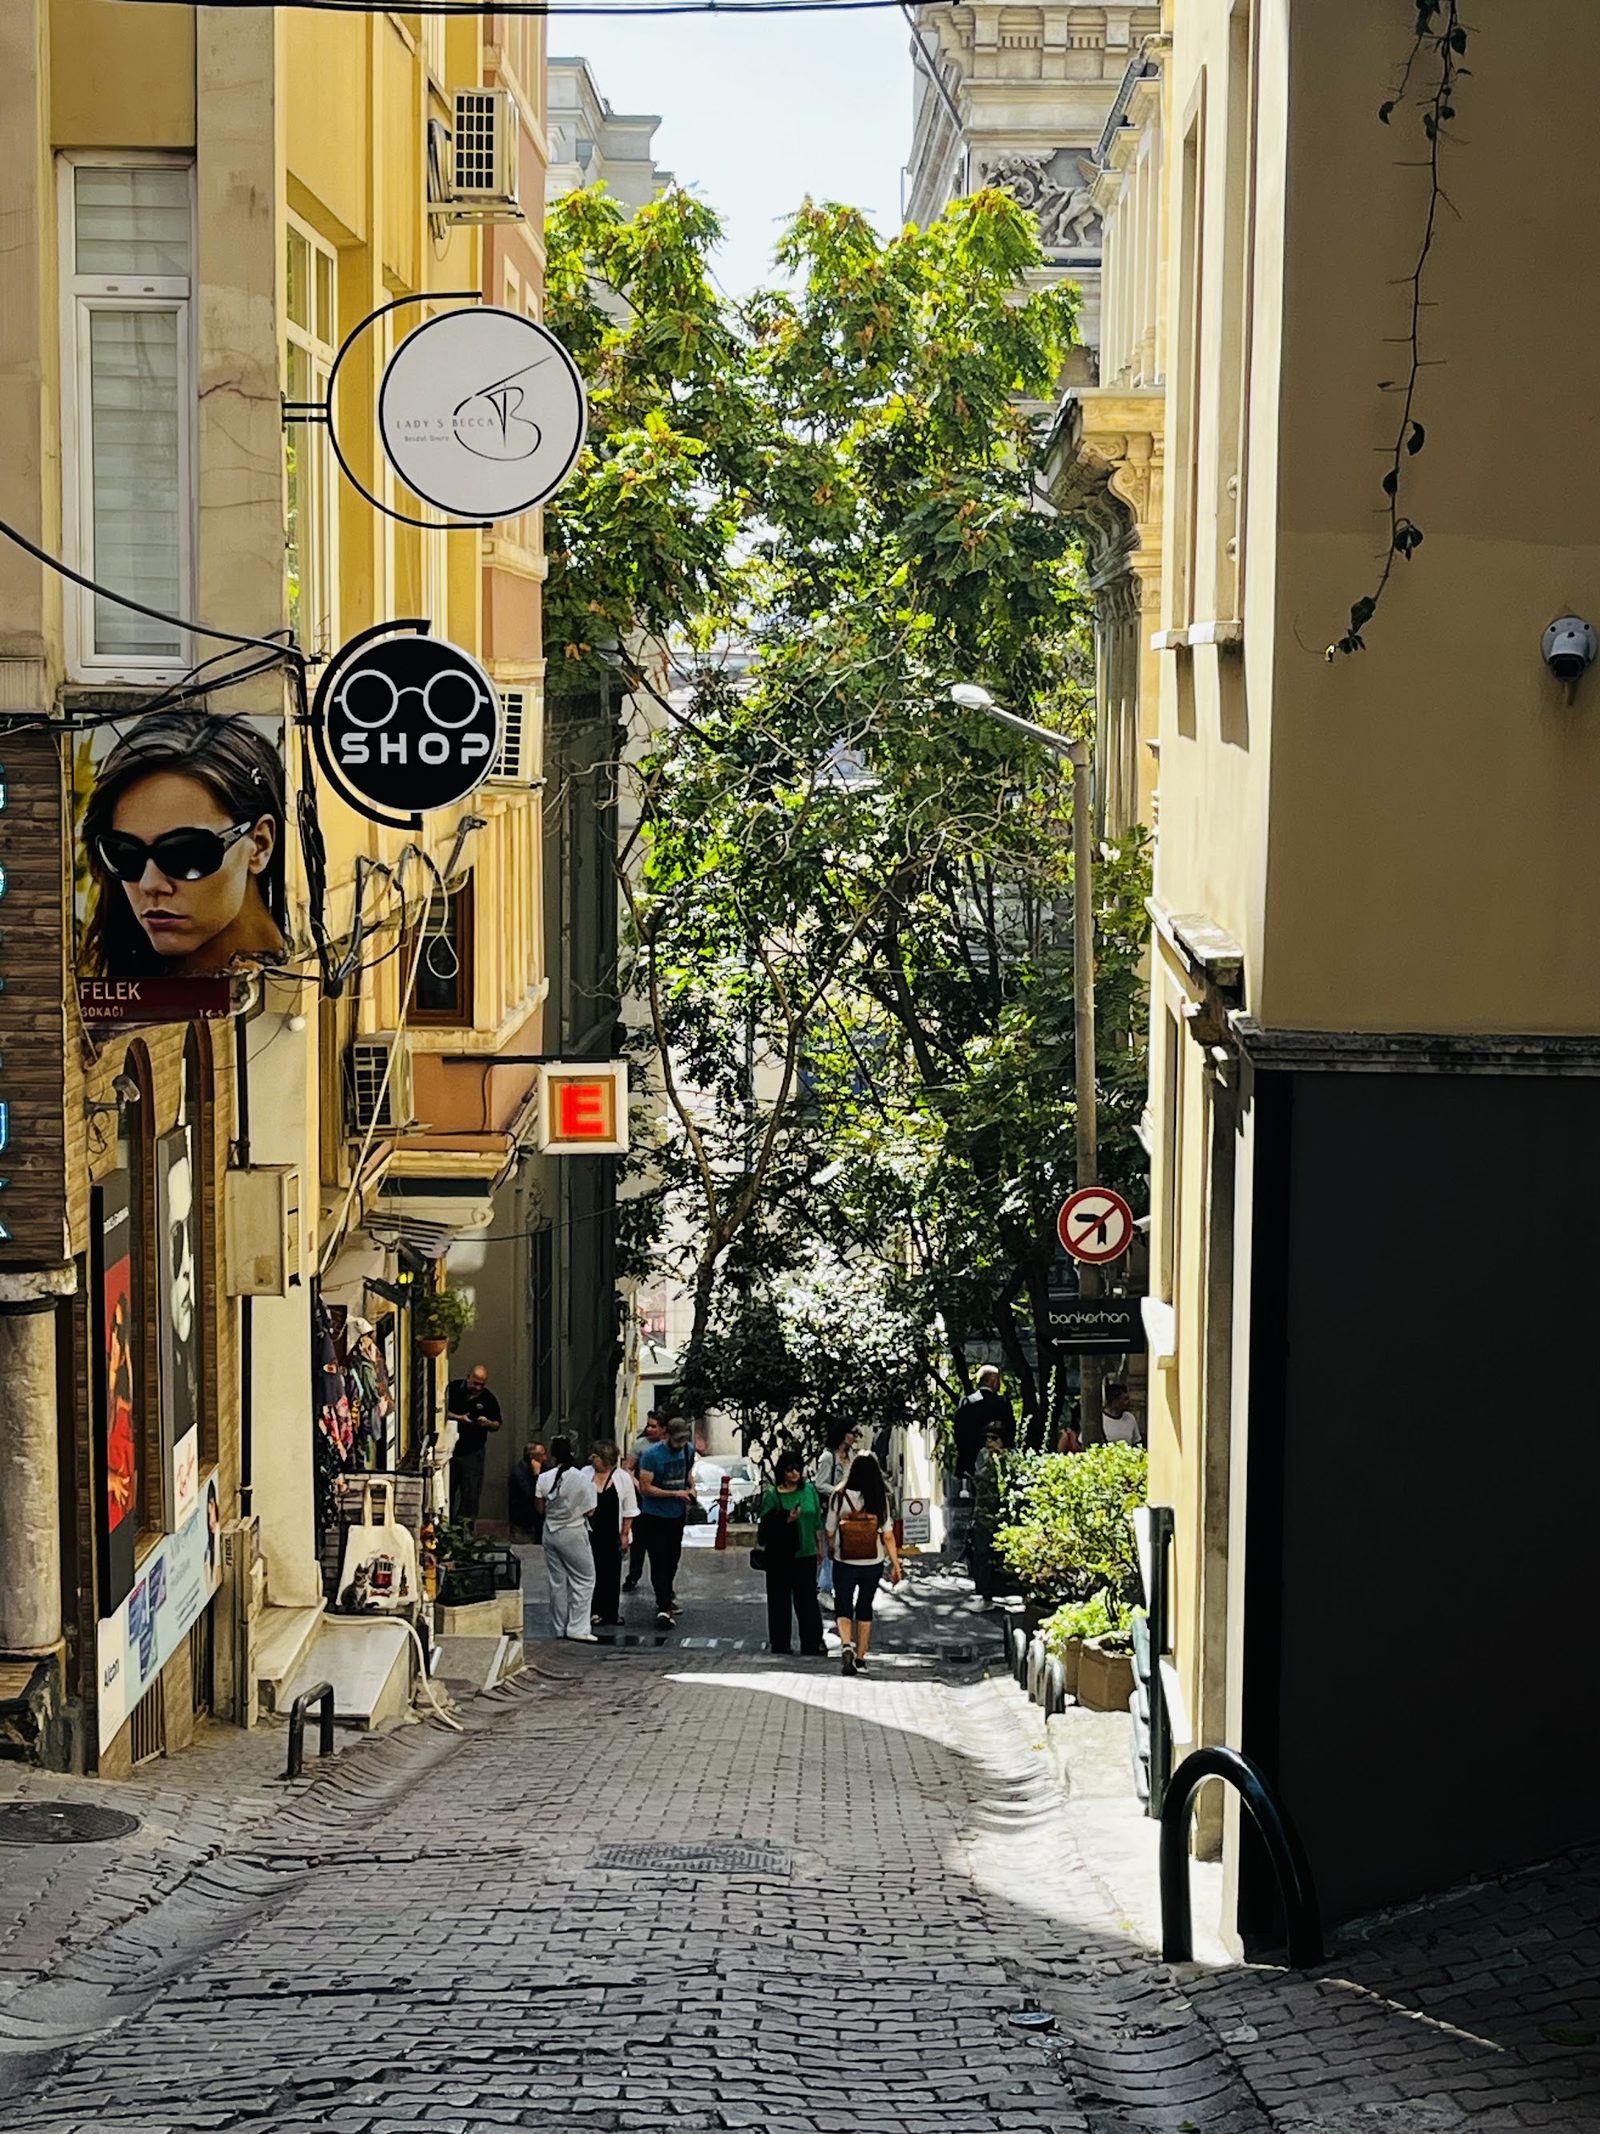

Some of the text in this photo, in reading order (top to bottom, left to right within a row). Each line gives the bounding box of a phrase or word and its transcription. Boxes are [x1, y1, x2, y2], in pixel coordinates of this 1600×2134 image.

[452, 417, 495, 427] BECCA
[340, 732, 490, 765] SHOP
[80, 982, 141, 1000] FELEK
[561, 1083, 604, 1135] E
